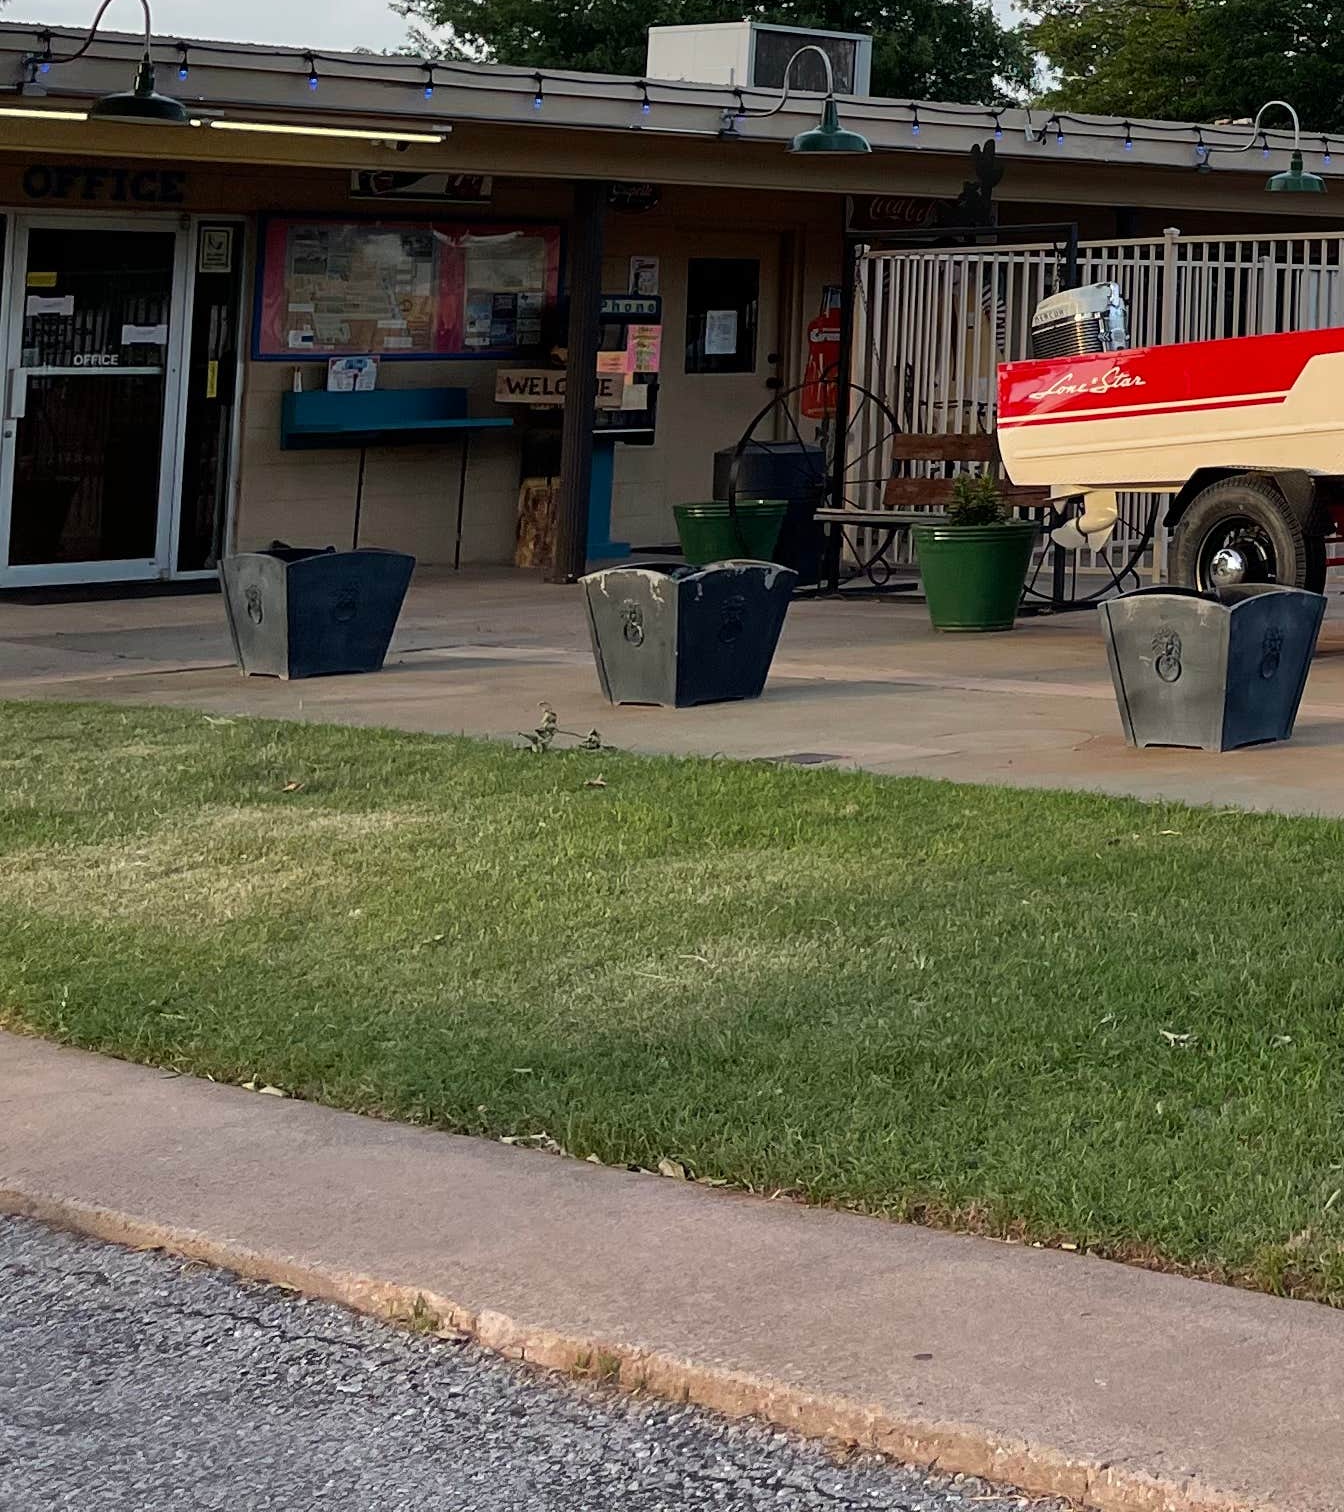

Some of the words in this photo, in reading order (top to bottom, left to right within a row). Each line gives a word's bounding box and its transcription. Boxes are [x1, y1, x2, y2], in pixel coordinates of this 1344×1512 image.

[22, 165, 186, 202] OFFICE
[73, 354, 119, 366] OFFICE
[506, 376, 613, 396] WELCE
[1029, 373, 1088, 399] Lone
[1089, 366, 1146, 393] Star
